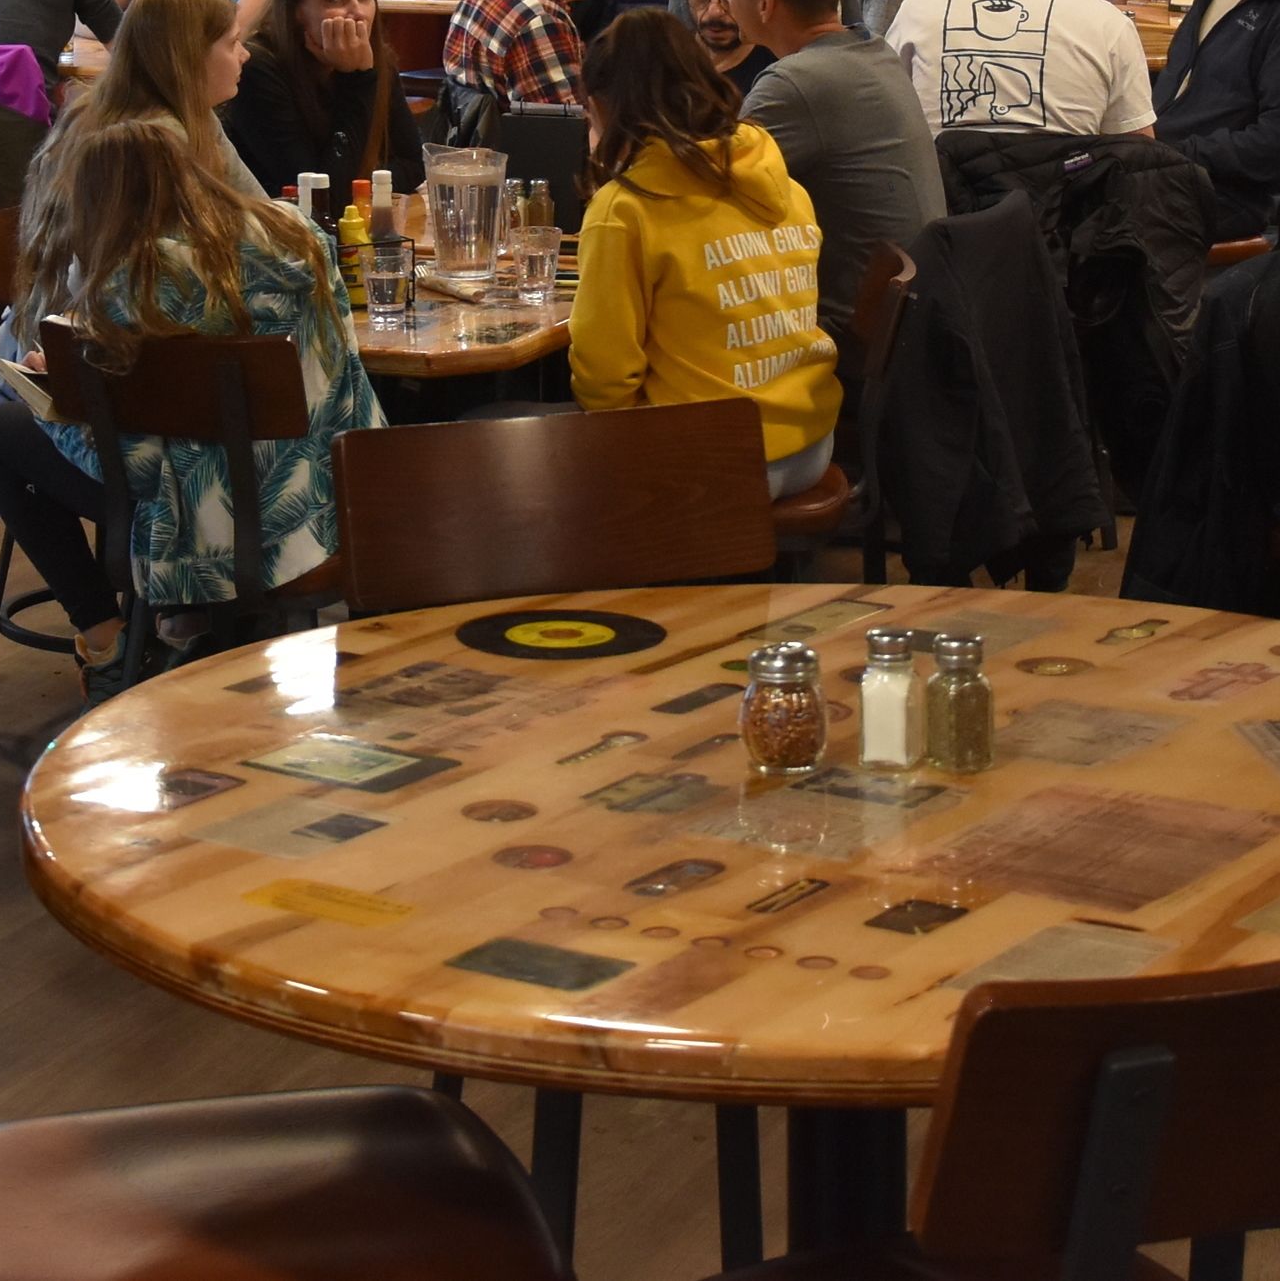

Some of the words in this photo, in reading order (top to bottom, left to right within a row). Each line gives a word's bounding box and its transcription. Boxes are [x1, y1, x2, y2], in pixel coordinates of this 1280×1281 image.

[704, 231, 772, 270] ALUMNI
[772, 224, 820, 254] GIRLS
[785, 264, 818, 294] GIRL
[726, 309, 793, 350] ALUMN
